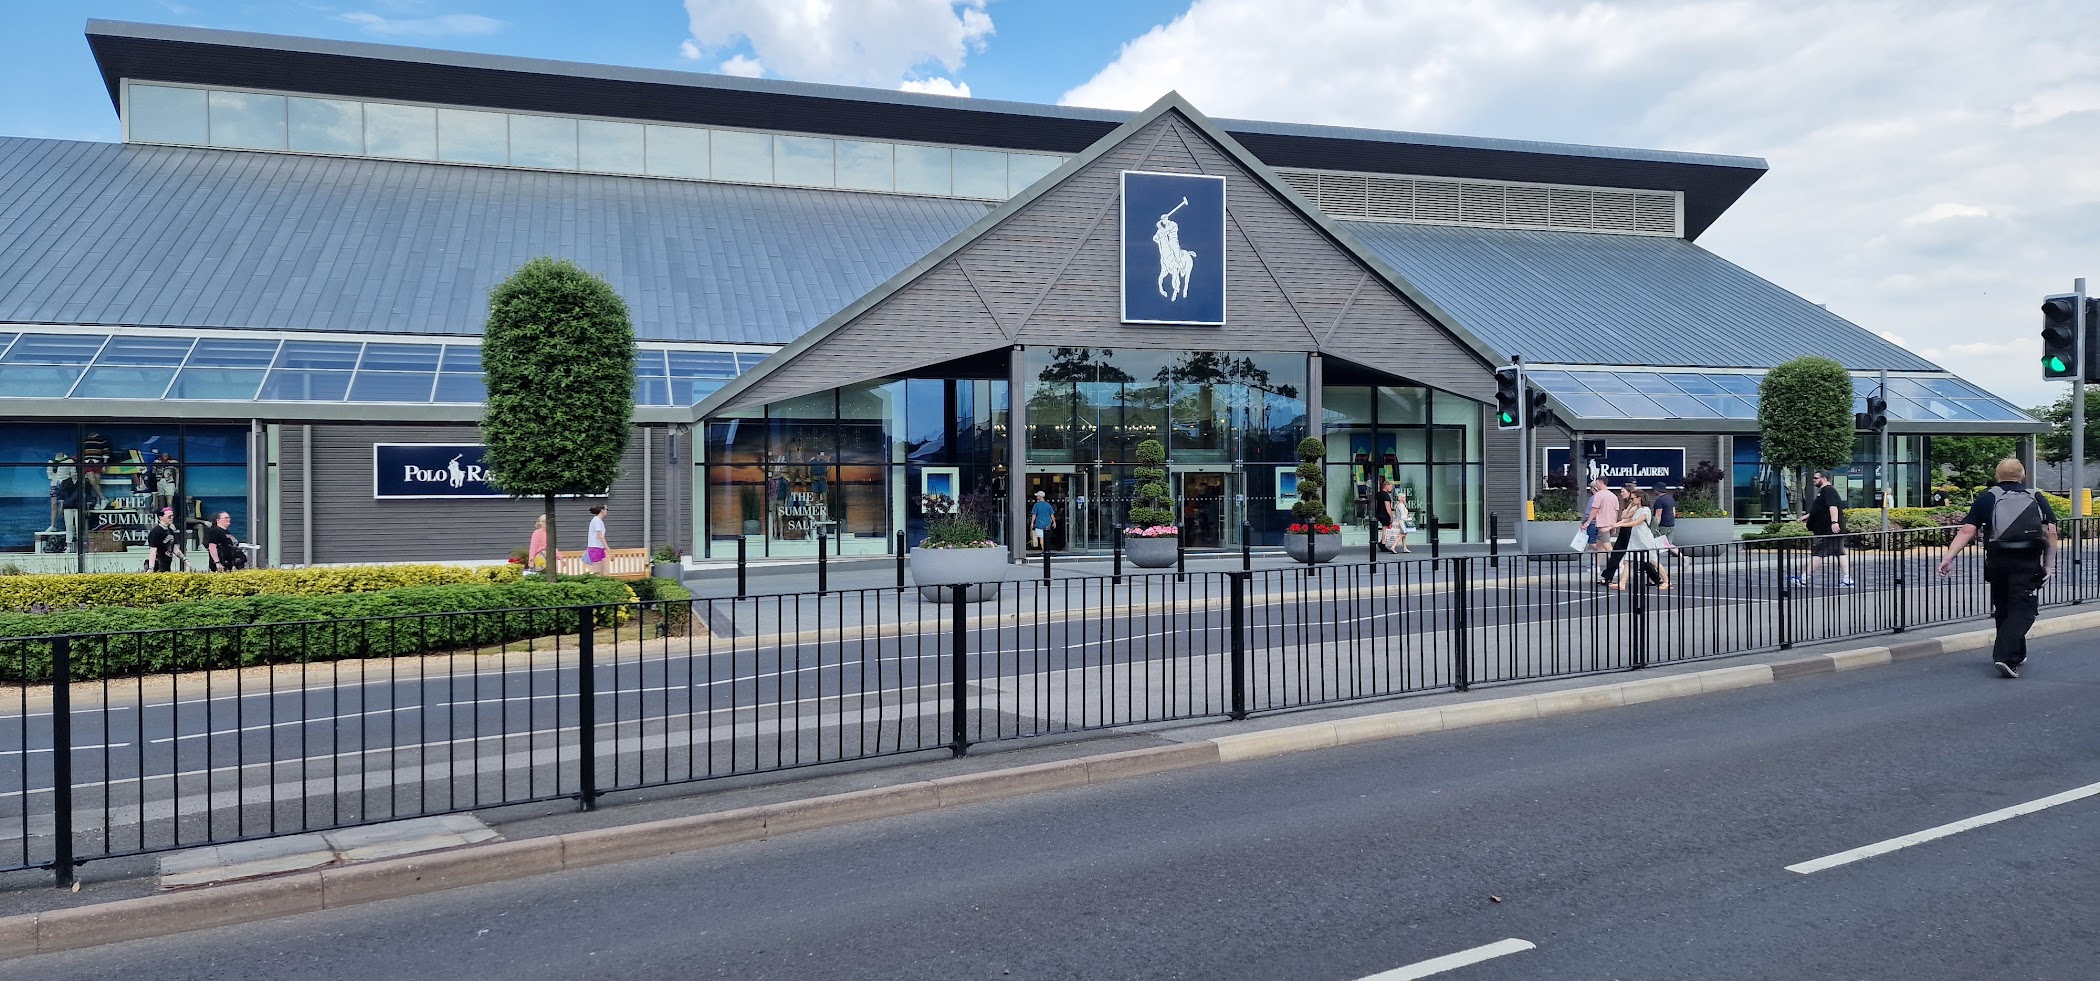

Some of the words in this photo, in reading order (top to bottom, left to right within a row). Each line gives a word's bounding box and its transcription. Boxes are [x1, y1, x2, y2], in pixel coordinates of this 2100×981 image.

[404, 465, 447, 482] POLO
[1600, 463, 1632, 477] RALPH
[1633, 463, 1670, 477] LAUREN
[116, 497, 146, 508] THE
[790, 492, 814, 502] THE
[778, 506, 828, 516] SUMMER
[788, 520, 817, 530] SALE
[112, 530, 150, 542] SALE
